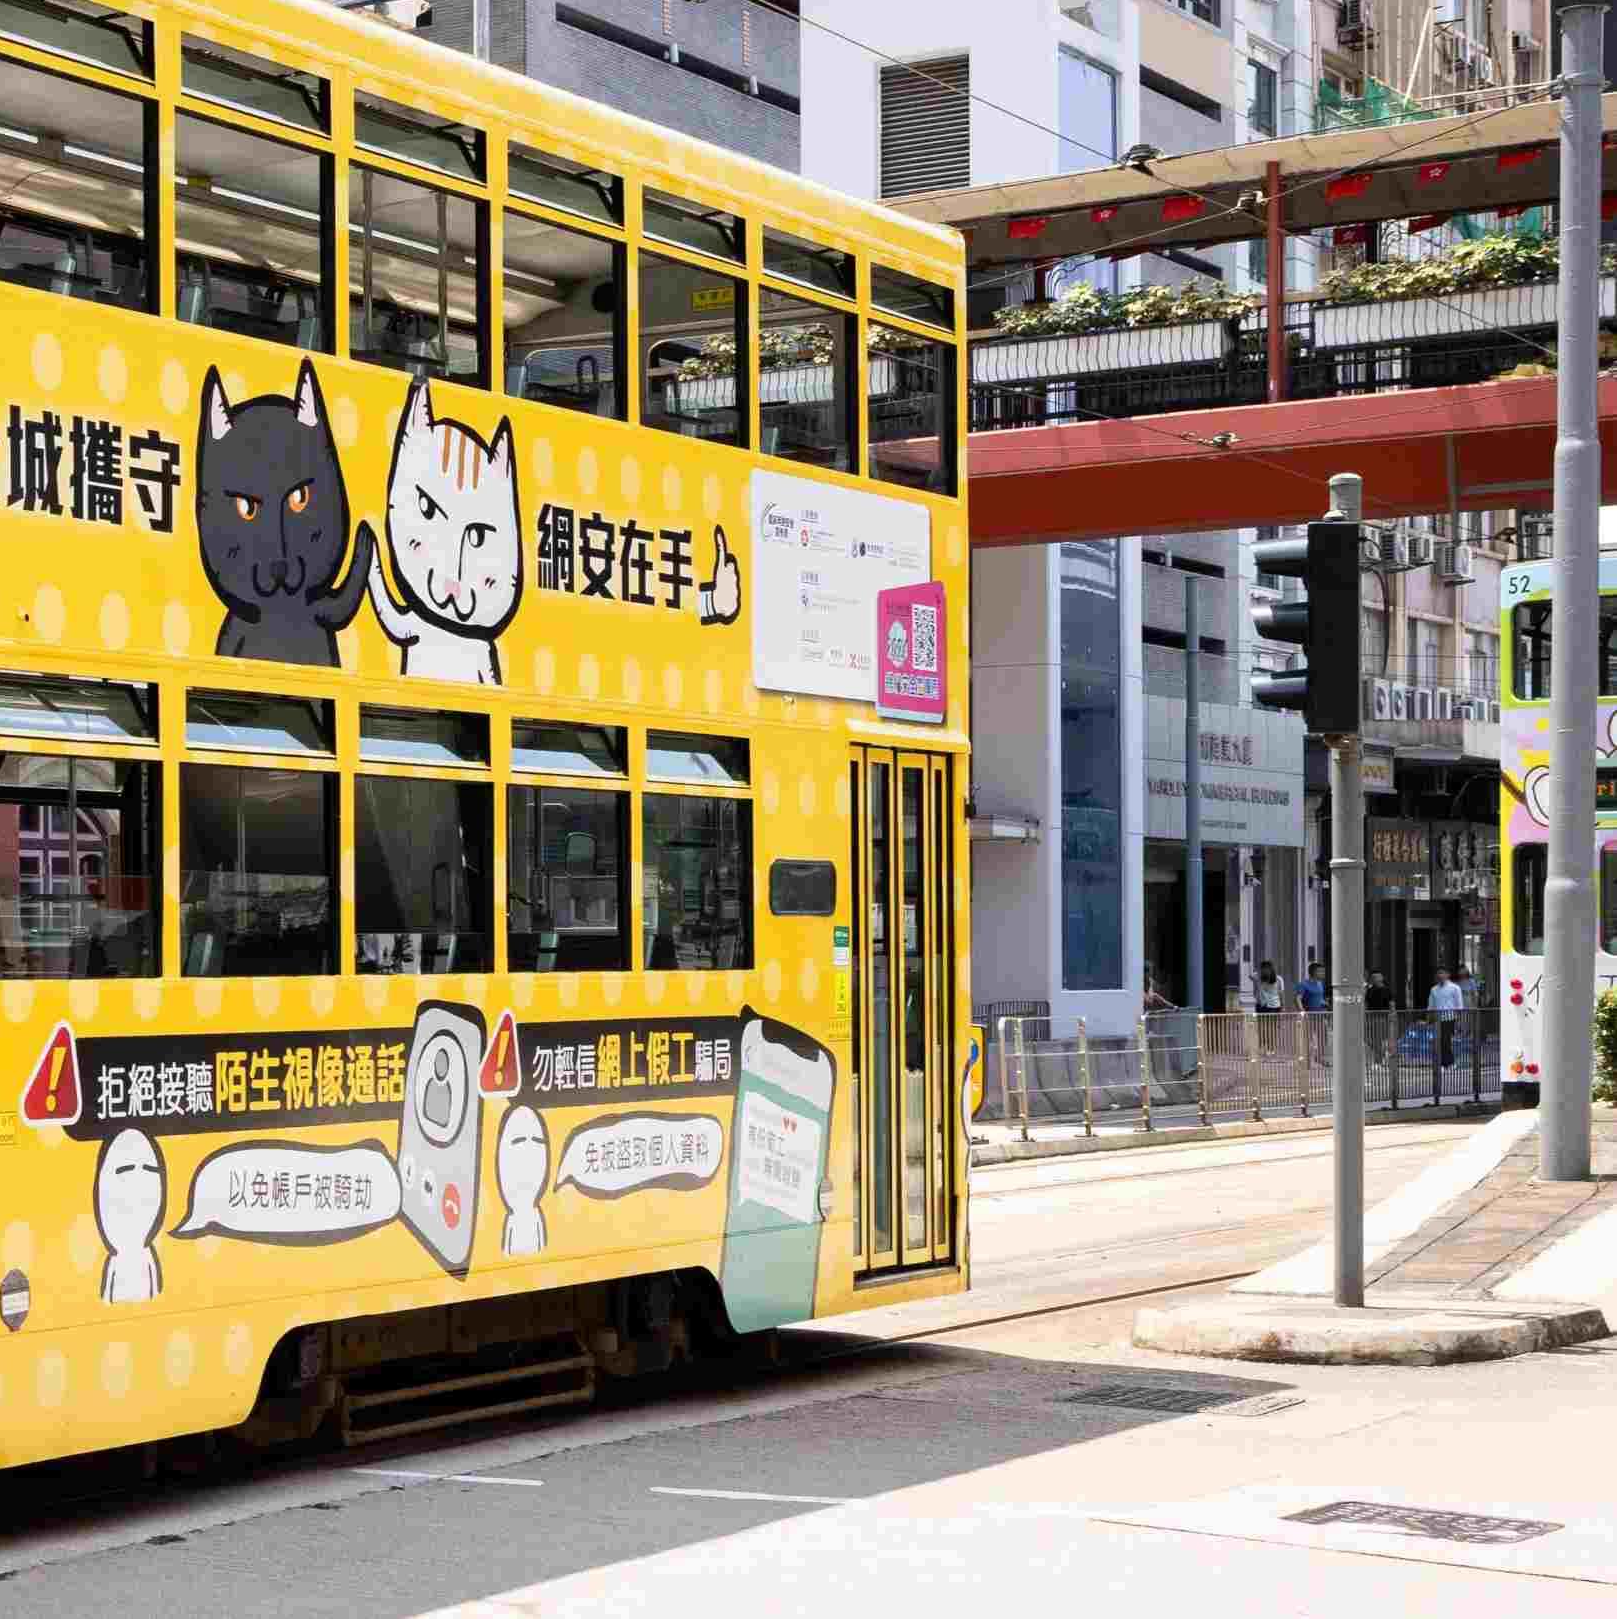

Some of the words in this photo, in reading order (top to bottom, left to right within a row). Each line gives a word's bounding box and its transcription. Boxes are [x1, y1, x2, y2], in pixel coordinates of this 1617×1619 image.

[537, 502, 694, 611] 網安在手
[1508, 575, 1531, 595] 52
[97, 1043, 407, 1120] 拒絕接聽陌生視像通話
[532, 1030, 732, 1092] 勿輕信網上假工騙局
[228, 1171, 374, 1210] 以免帳戶被騎劫
